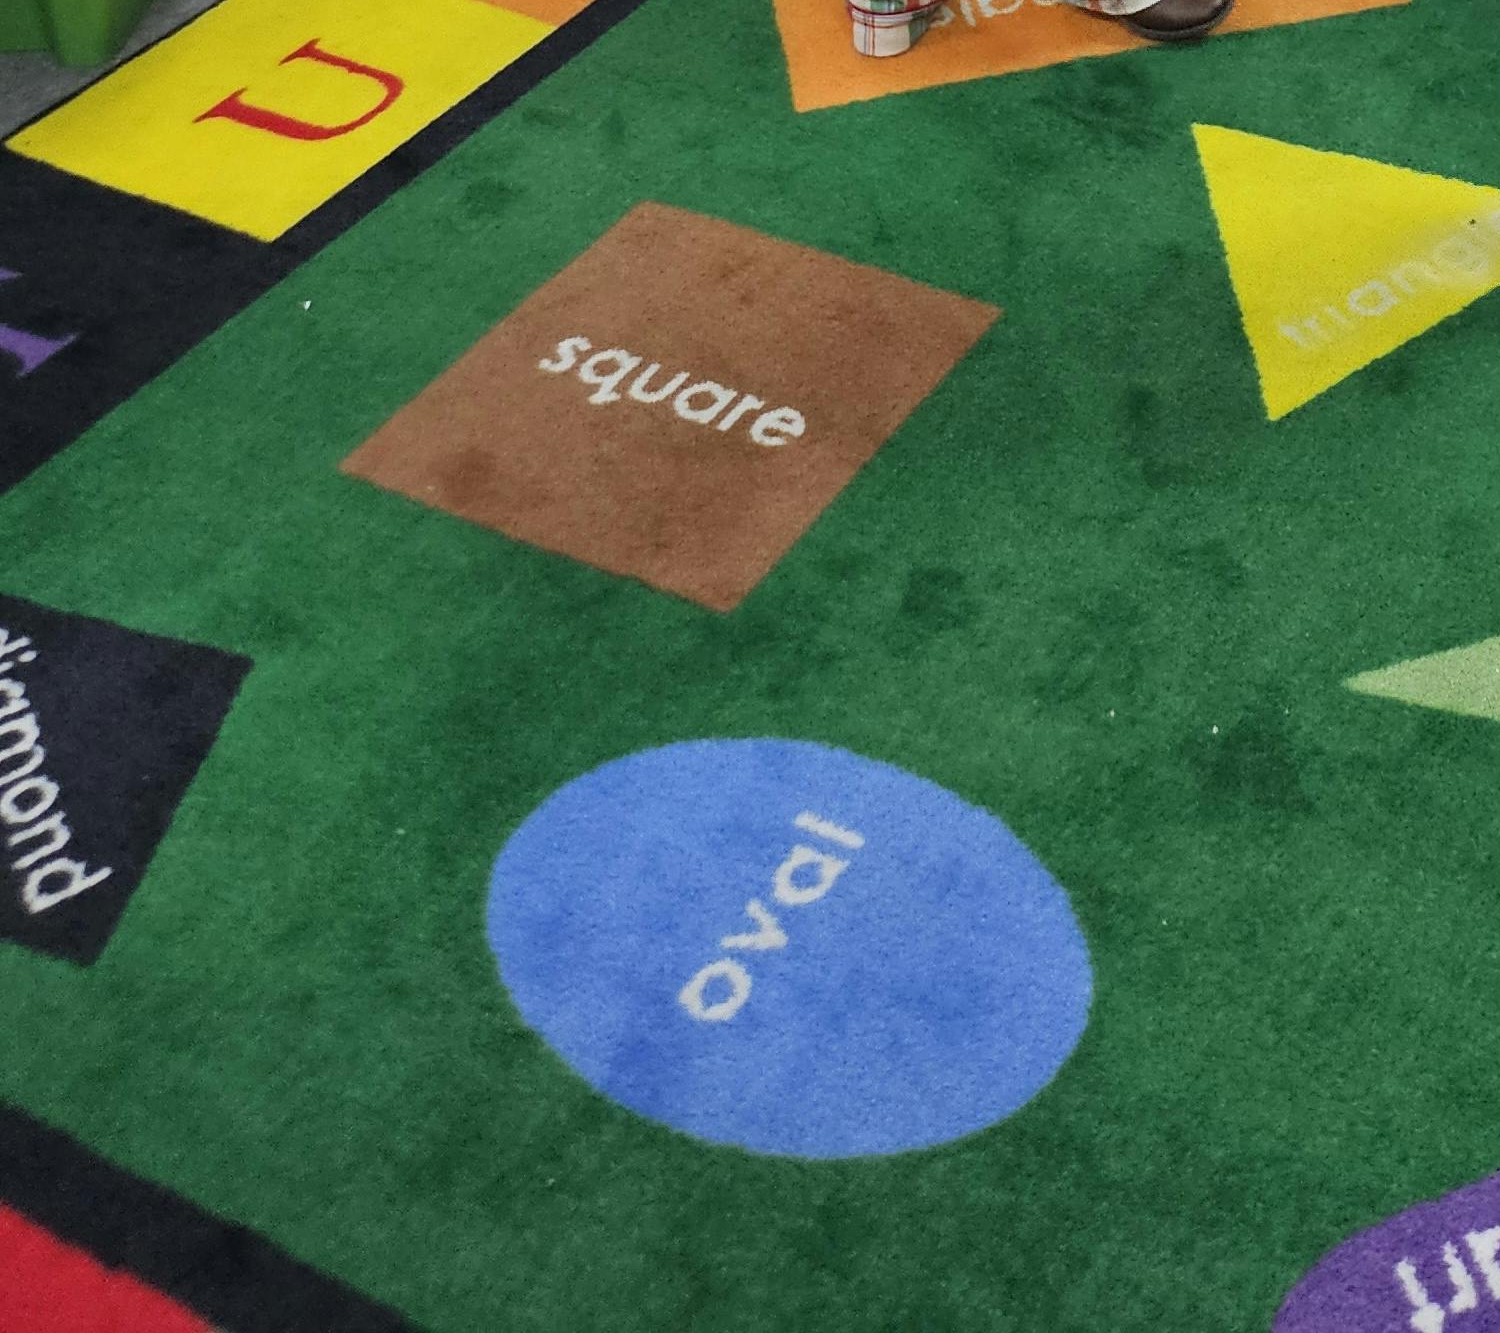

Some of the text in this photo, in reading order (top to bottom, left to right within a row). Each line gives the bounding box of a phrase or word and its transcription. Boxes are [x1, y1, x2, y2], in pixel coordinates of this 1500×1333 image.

[193, 37, 404, 142] U
[539, 333, 809, 451] square
[678, 813, 865, 1024] oval
